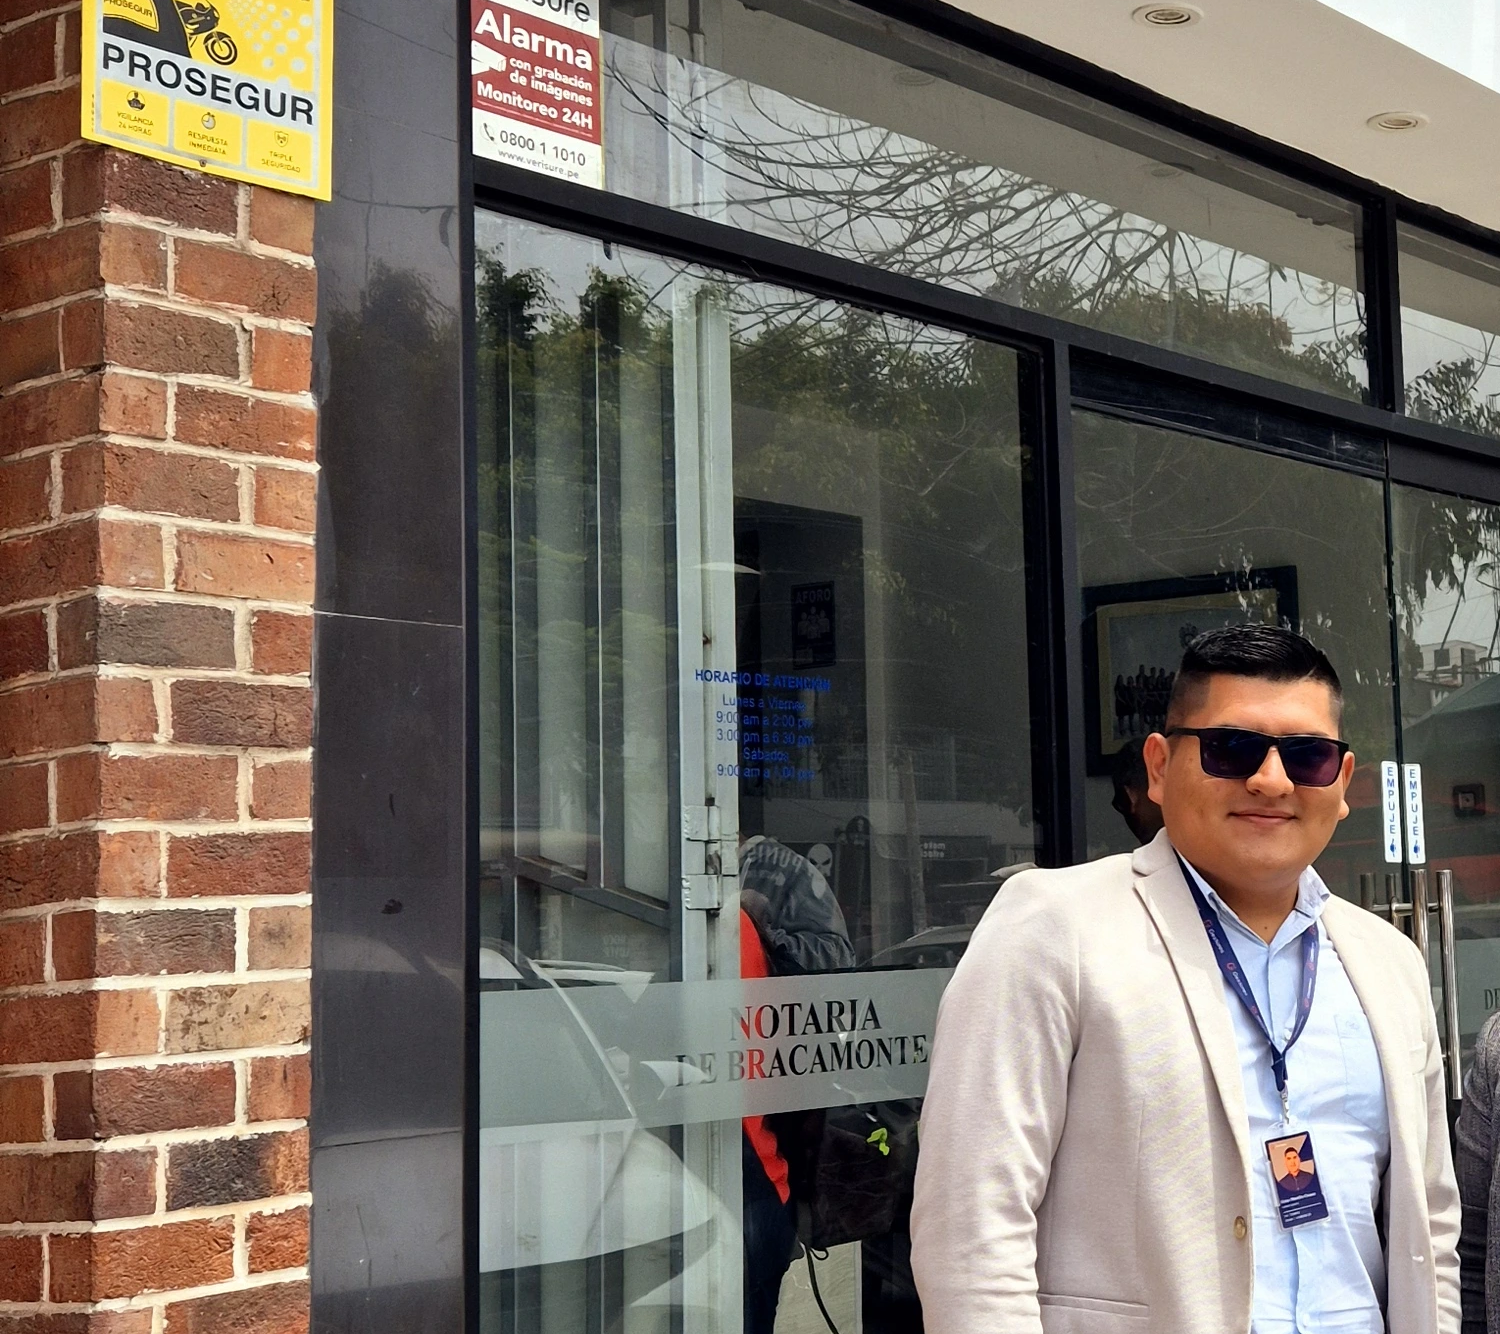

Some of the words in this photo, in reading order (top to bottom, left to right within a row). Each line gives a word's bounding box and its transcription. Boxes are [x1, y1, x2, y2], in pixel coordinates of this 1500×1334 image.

[474, 8, 593, 71] Alarma
[103, 42, 314, 125] PROSEGUR
[510, 56, 531, 72] con
[535, 64, 593, 93] grabación
[510, 70, 527, 87] de
[531, 76, 593, 107] imágenes
[477, 80, 558, 120] Monitoreo
[562, 107, 593, 130] 24H
[498, 149, 579, 180] www.verisure.pe
[500, 130, 535, 151] 0800
[540, 142, 547, 155] 1
[553, 146, 586, 166] 1010
[695, 669, 751, 685] HORARIO
[755, 673, 770, 686] DE
[716, 711, 739, 724] 9:00
[743, 715, 759, 725] am
[762, 716, 769, 726] a
[722, 693, 755, 708] Lunes
[758, 699, 764, 708] a
[716, 729, 739, 741] 3:00
[743, 733, 760, 744] pm
[763, 734, 769, 743] a
[717, 764, 739, 777] 9:00
[743, 768, 761, 777] am
[1386, 766, 1397, 835] EMPUJE
[1409, 768, 1420, 837] EMPUJE
[730, 998, 882, 1041] NOTARIA
[675, 1053, 717, 1087] DE
[727, 1034, 928, 1082] BRACAMONTE
